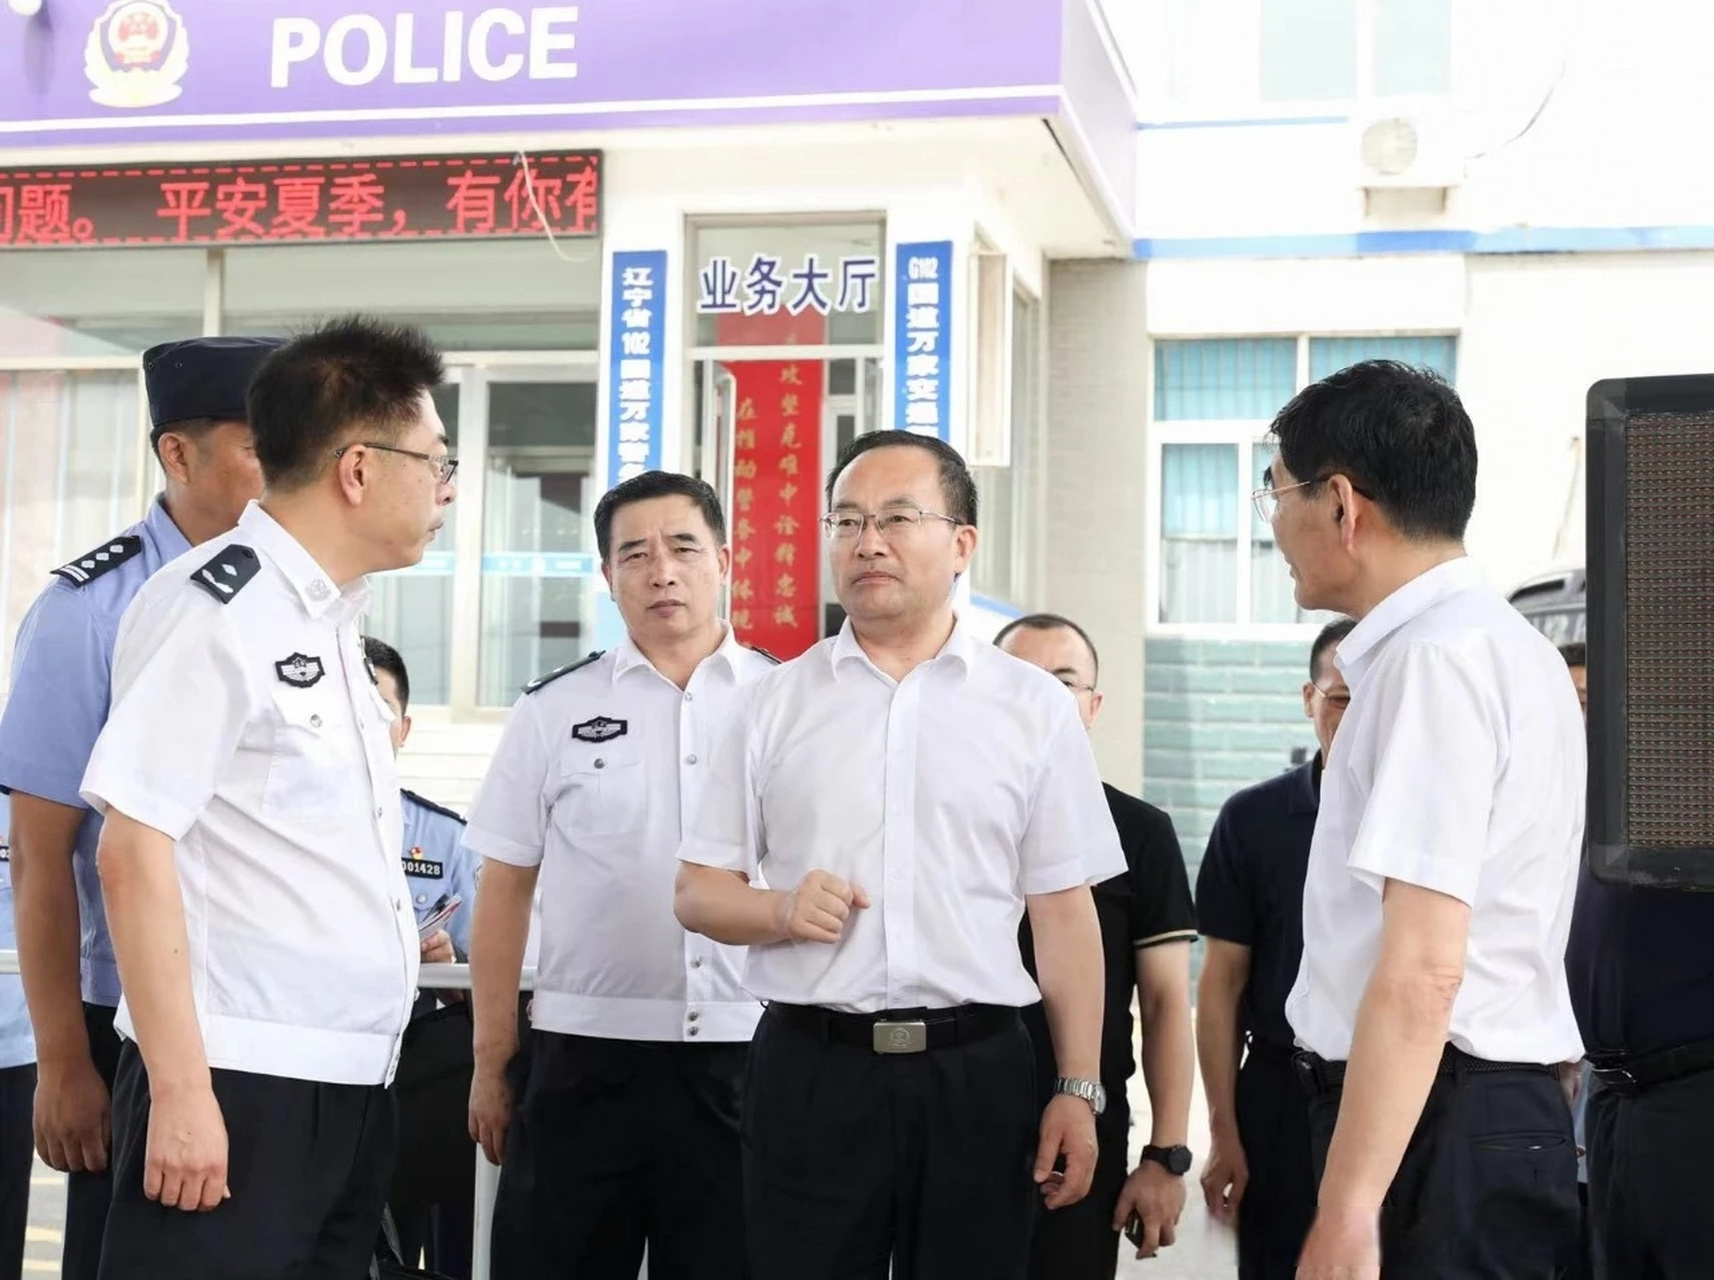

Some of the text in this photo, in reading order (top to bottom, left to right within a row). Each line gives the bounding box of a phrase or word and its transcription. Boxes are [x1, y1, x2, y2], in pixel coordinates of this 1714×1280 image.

[269, 6, 579, 88] POLICE
[0, 183, 94, 240] 题。
[698, 255, 879, 314] 业务大厅
